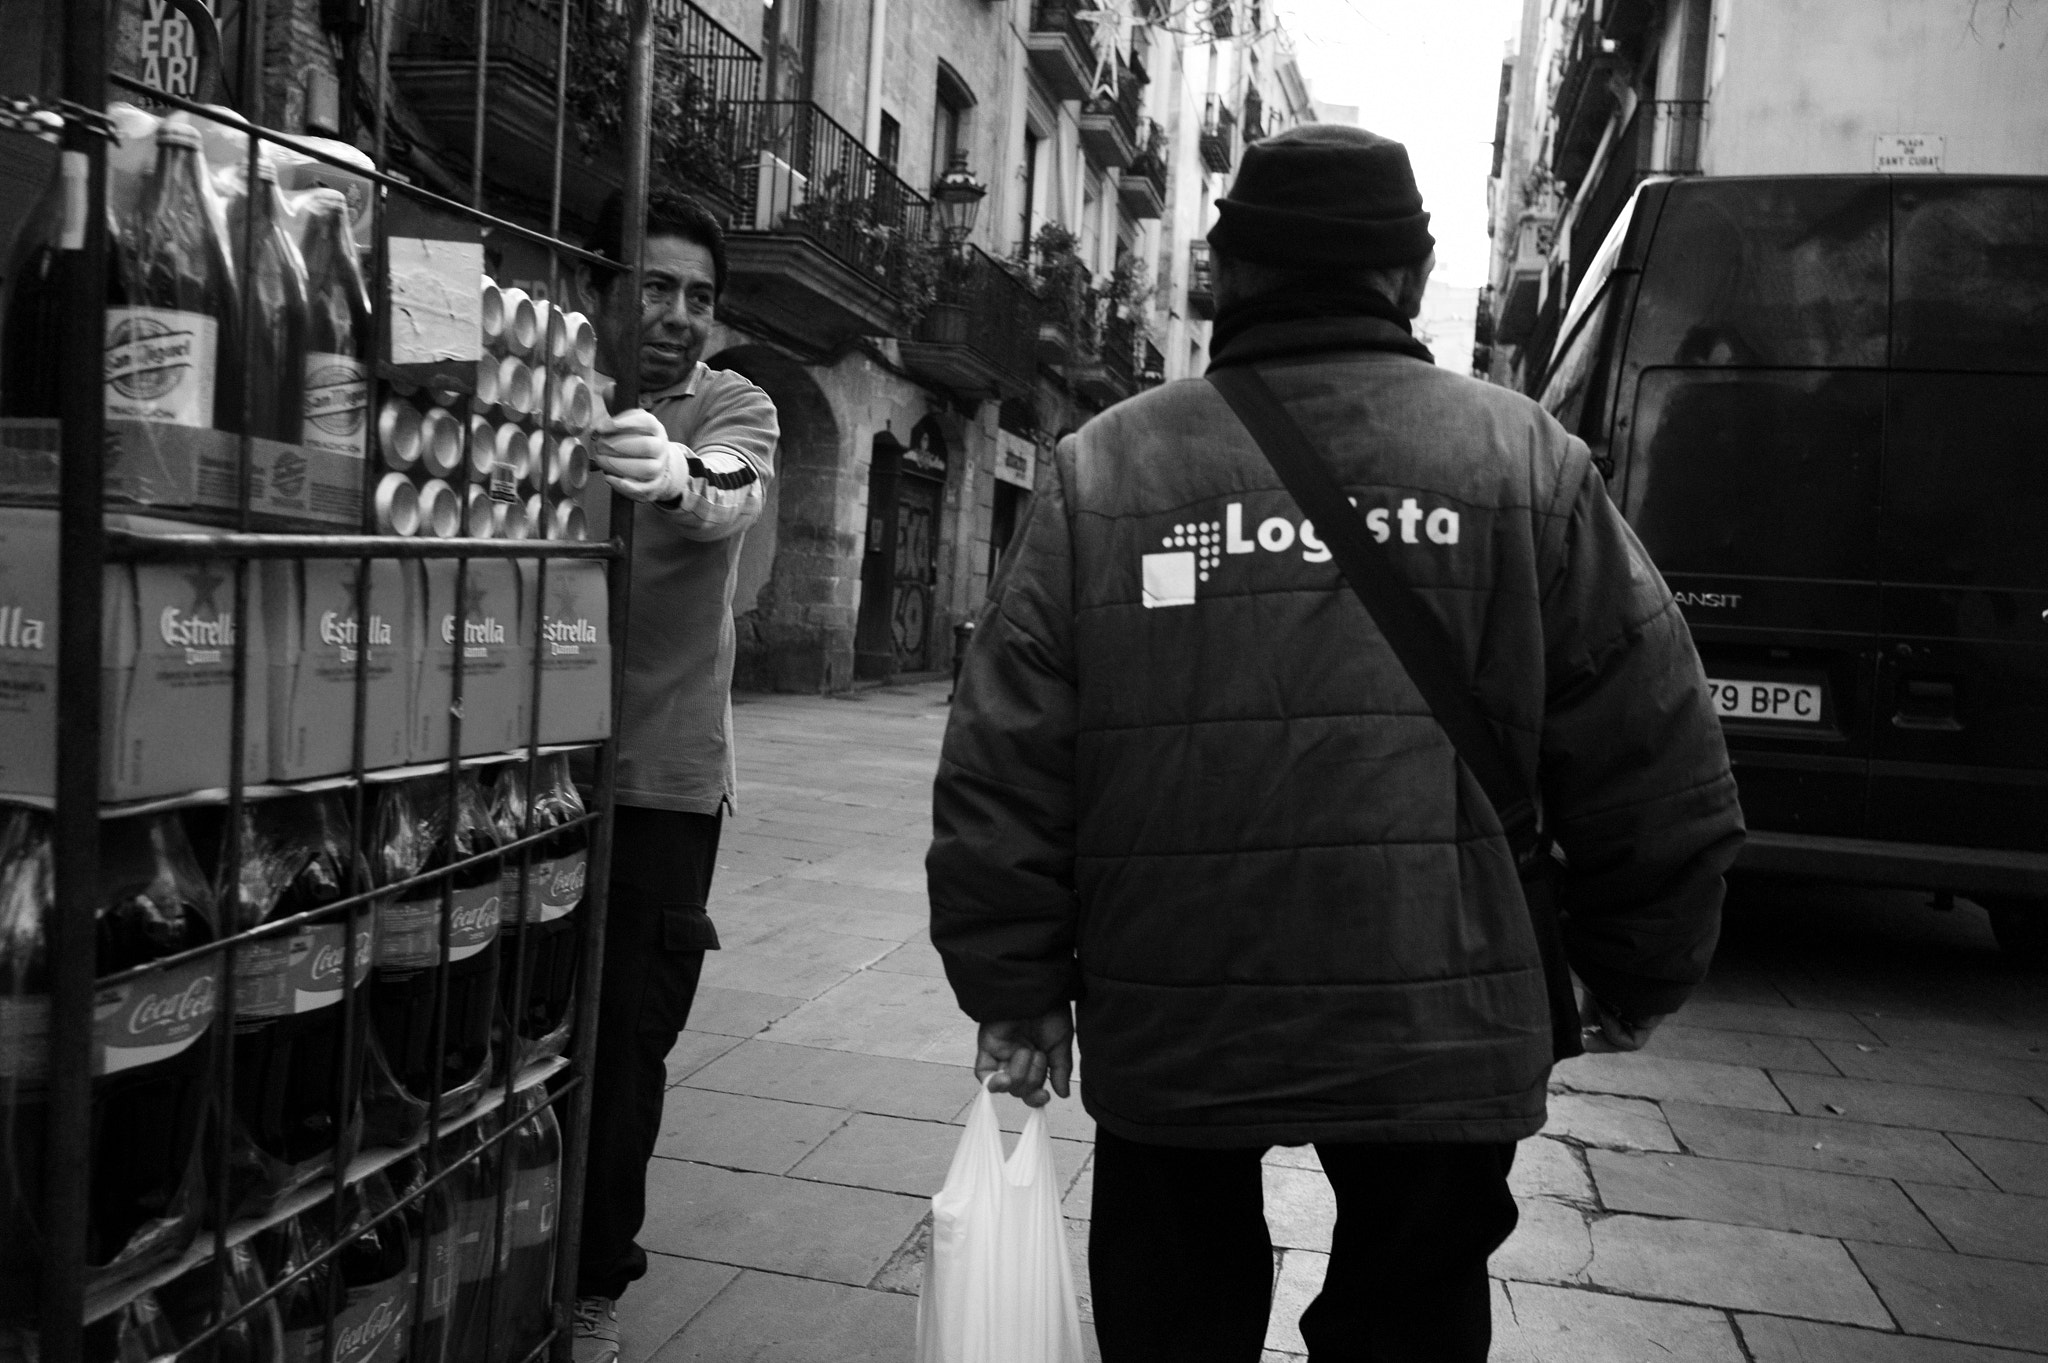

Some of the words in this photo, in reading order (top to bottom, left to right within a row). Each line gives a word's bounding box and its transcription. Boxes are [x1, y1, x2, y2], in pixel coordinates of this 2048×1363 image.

[1226, 497, 1460, 563] Logsta
[320, 611, 391, 645] Estrlla
[441, 614, 504, 644] Etrella
[463, 646, 489, 657] amm
[1751, 687, 1812, 716] BPC
